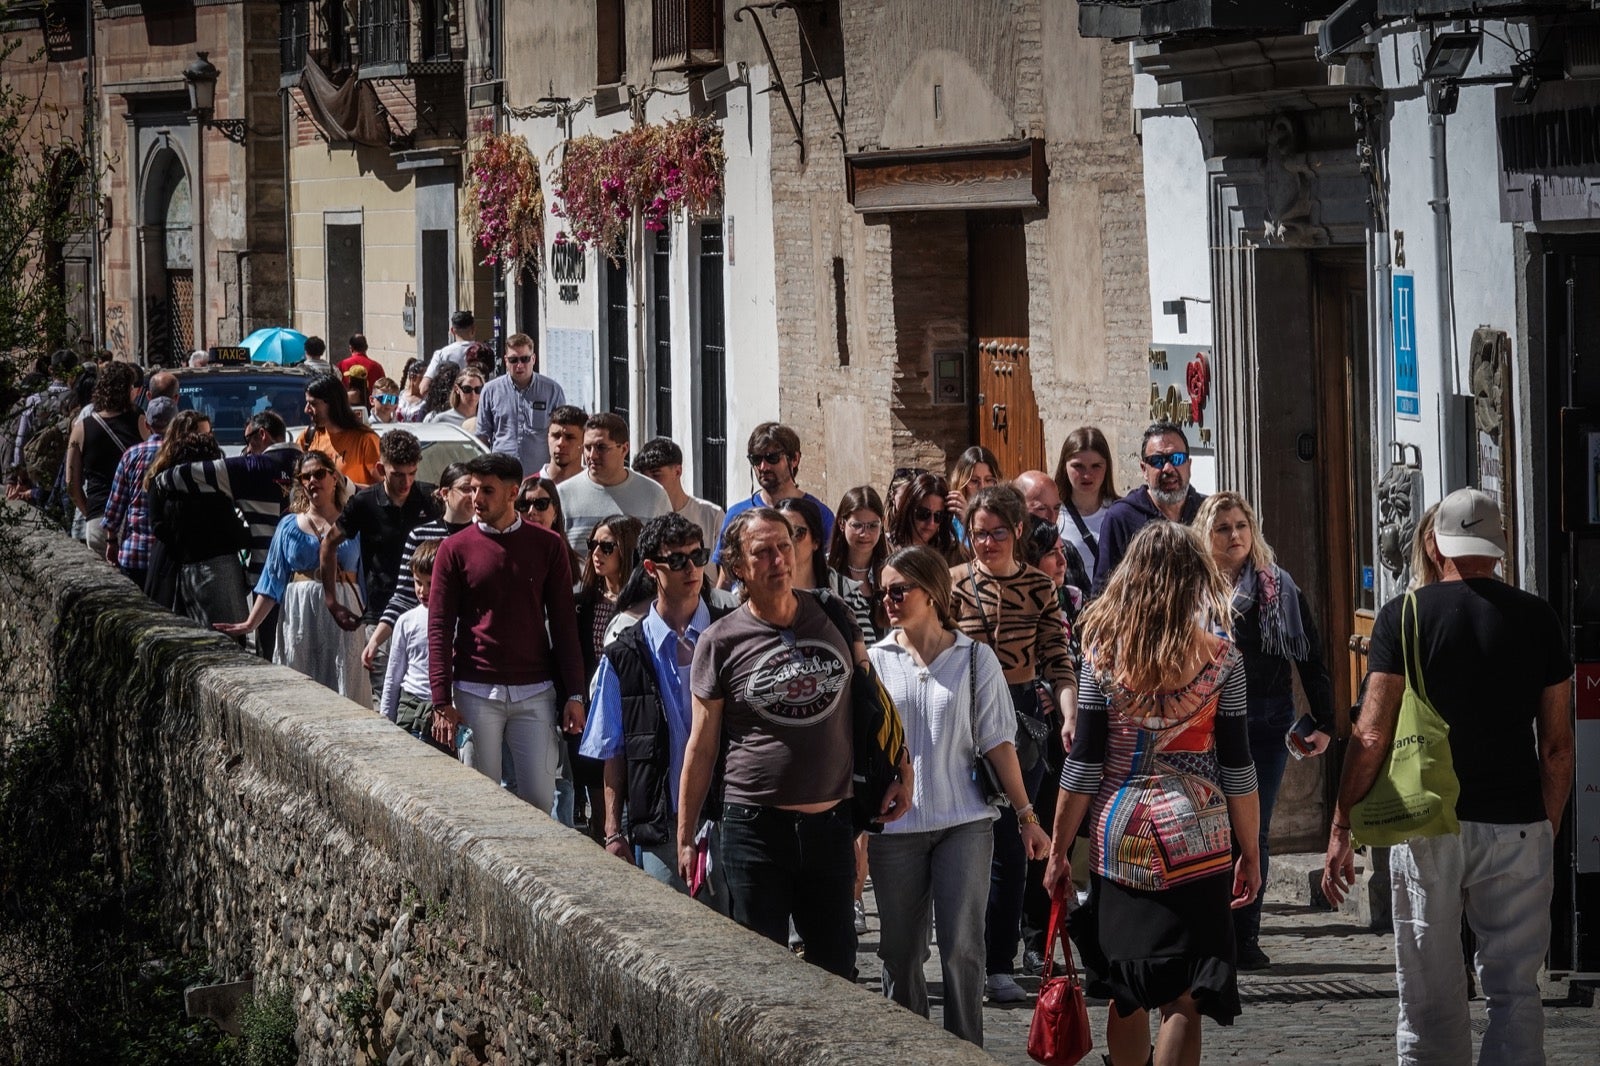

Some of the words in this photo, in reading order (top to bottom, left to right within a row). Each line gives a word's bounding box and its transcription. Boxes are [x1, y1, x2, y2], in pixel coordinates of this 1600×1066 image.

[1398, 287, 1411, 351] H
[217, 348, 239, 360] TAXI
[772, 694, 832, 716] SERVICE
